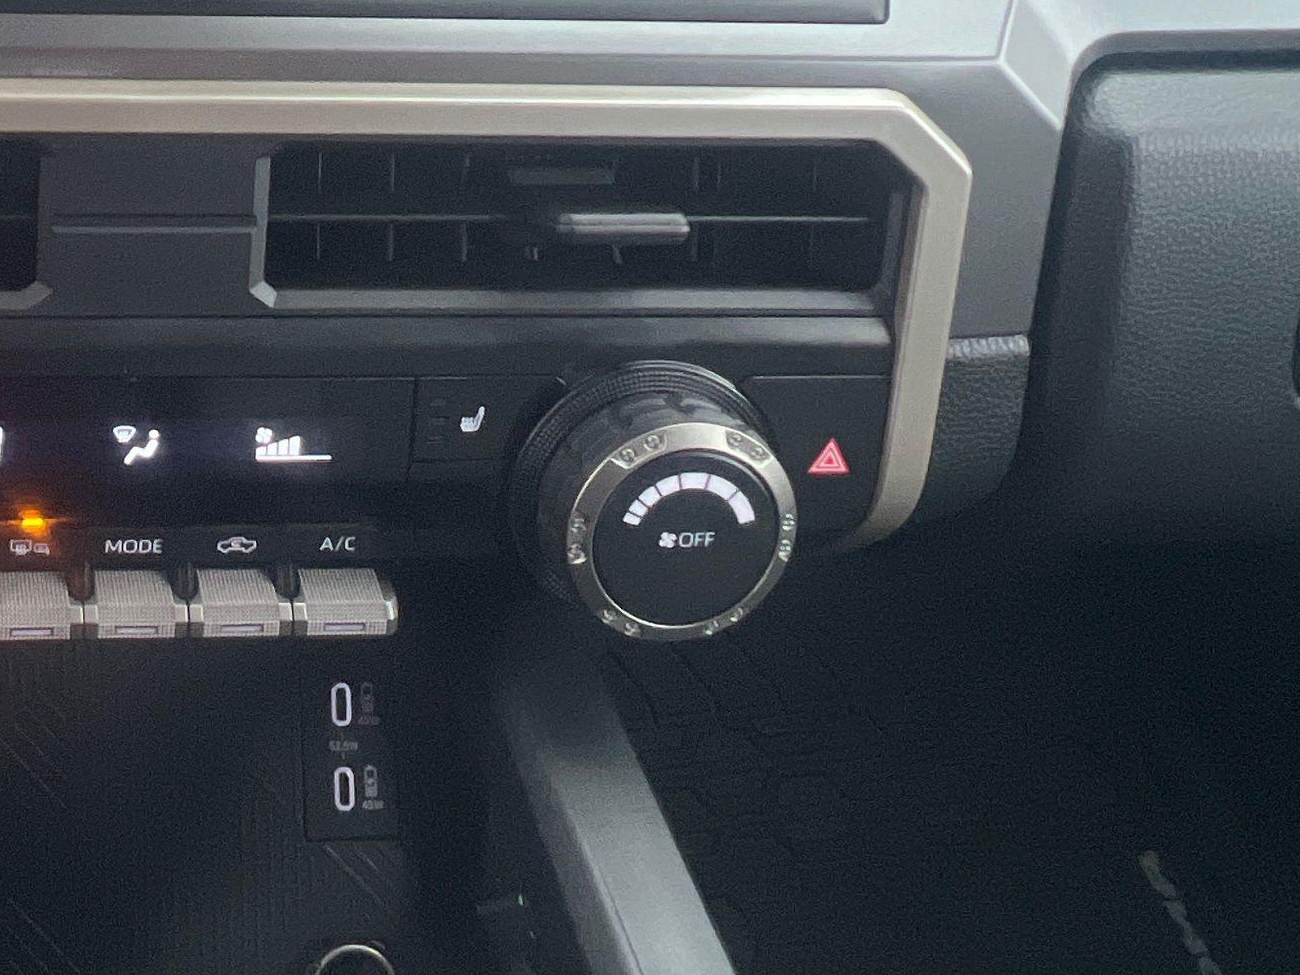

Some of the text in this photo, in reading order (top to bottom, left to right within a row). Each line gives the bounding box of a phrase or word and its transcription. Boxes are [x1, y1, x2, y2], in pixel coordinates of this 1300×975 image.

[105, 538, 163, 555] MODE
[320, 536, 357, 552] A/C
[678, 531, 716, 549] OFF
